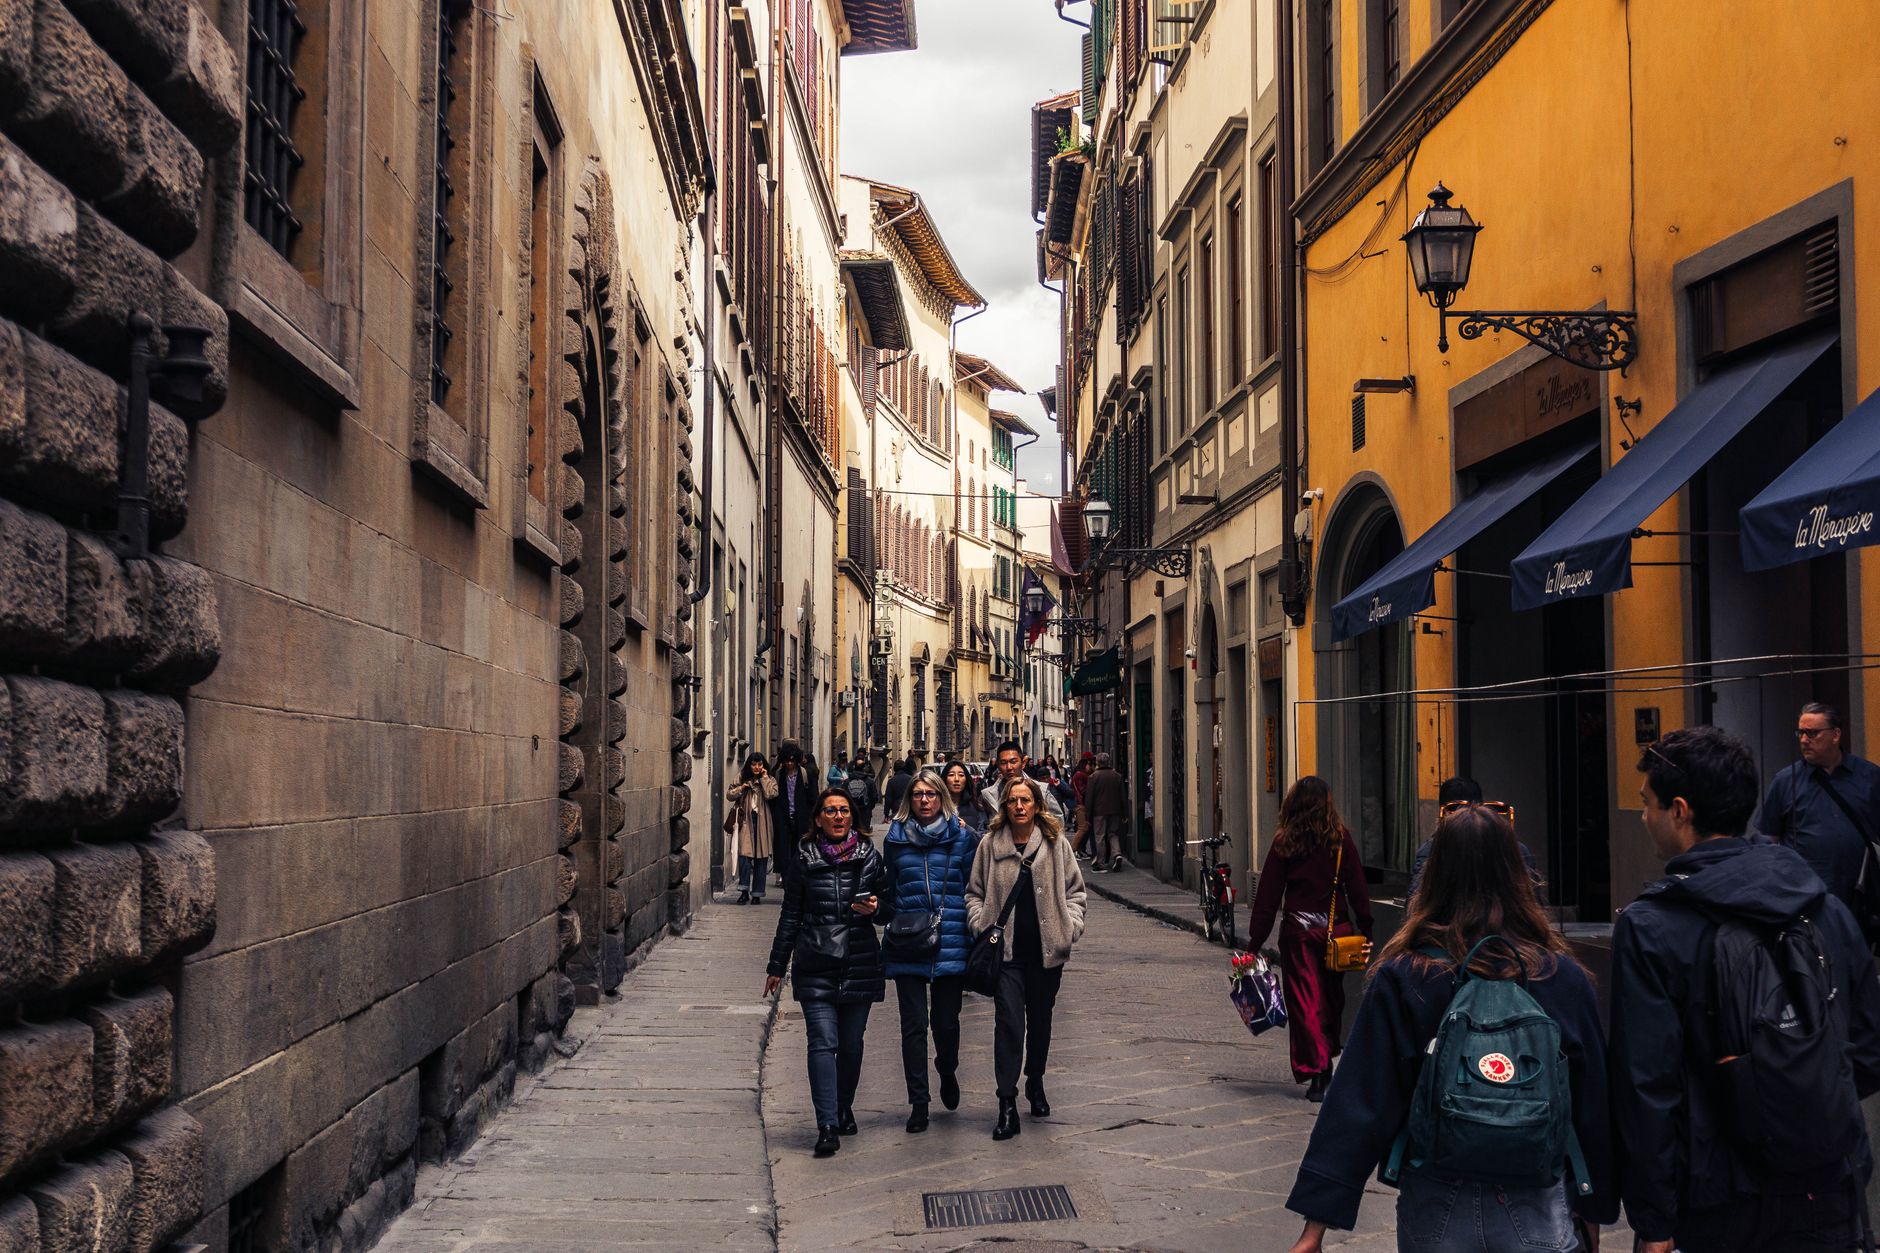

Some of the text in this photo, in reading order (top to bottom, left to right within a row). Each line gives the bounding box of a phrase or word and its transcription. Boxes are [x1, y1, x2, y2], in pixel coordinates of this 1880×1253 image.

[1795, 519, 1809, 548] la
[876, 569, 895, 655] HOTEL
[1779, 1020, 1799, 1029] deut
